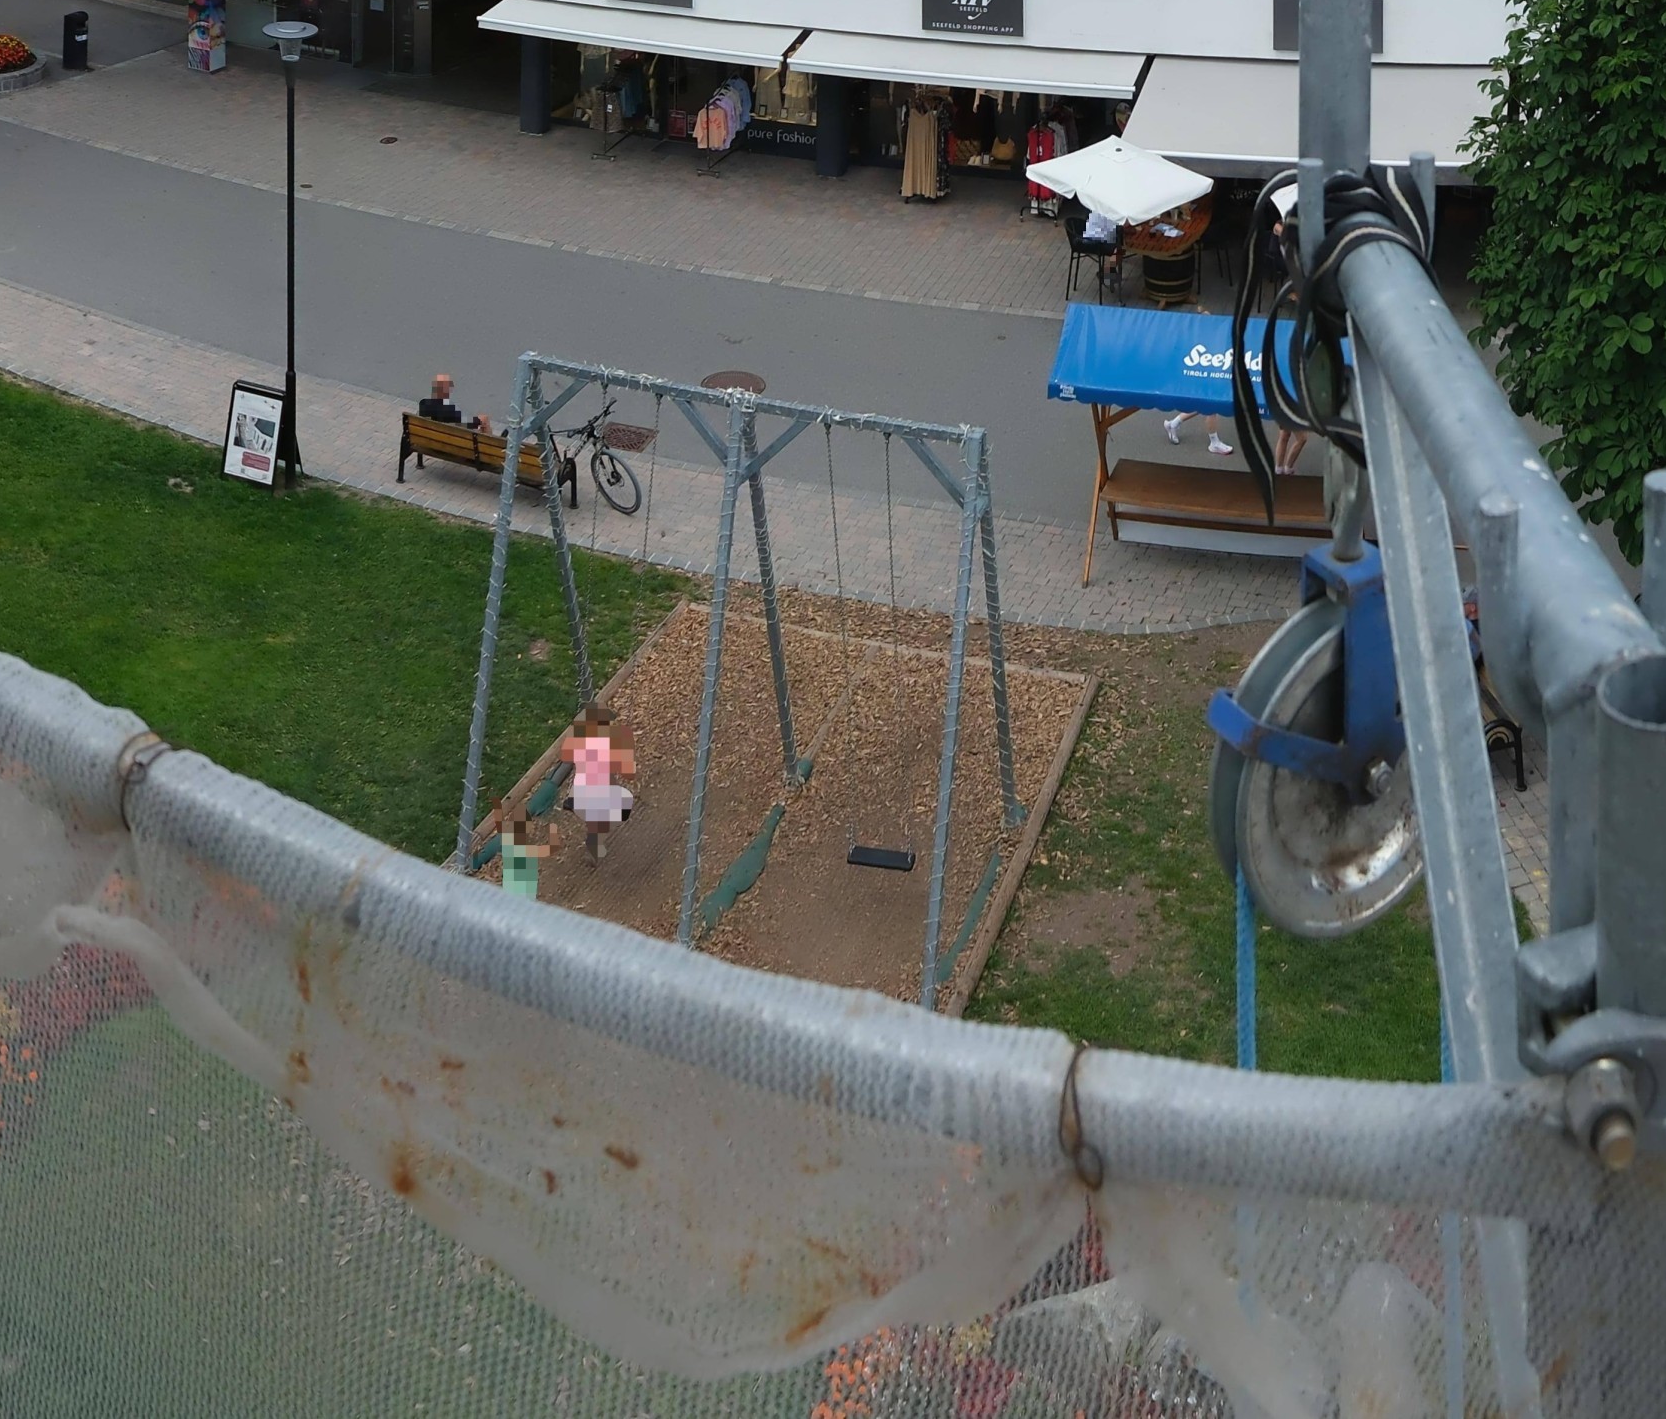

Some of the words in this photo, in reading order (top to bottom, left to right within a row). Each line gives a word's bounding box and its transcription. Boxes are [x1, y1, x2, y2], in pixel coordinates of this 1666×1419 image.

[959, 5, 988, 13] SEEFELD
[963, 24, 999, 32] SHOPPING
[747, 129, 773, 140] pure
[1183, 344, 1263, 371] Seefld
[1183, 370, 1208, 378] TIROLS
